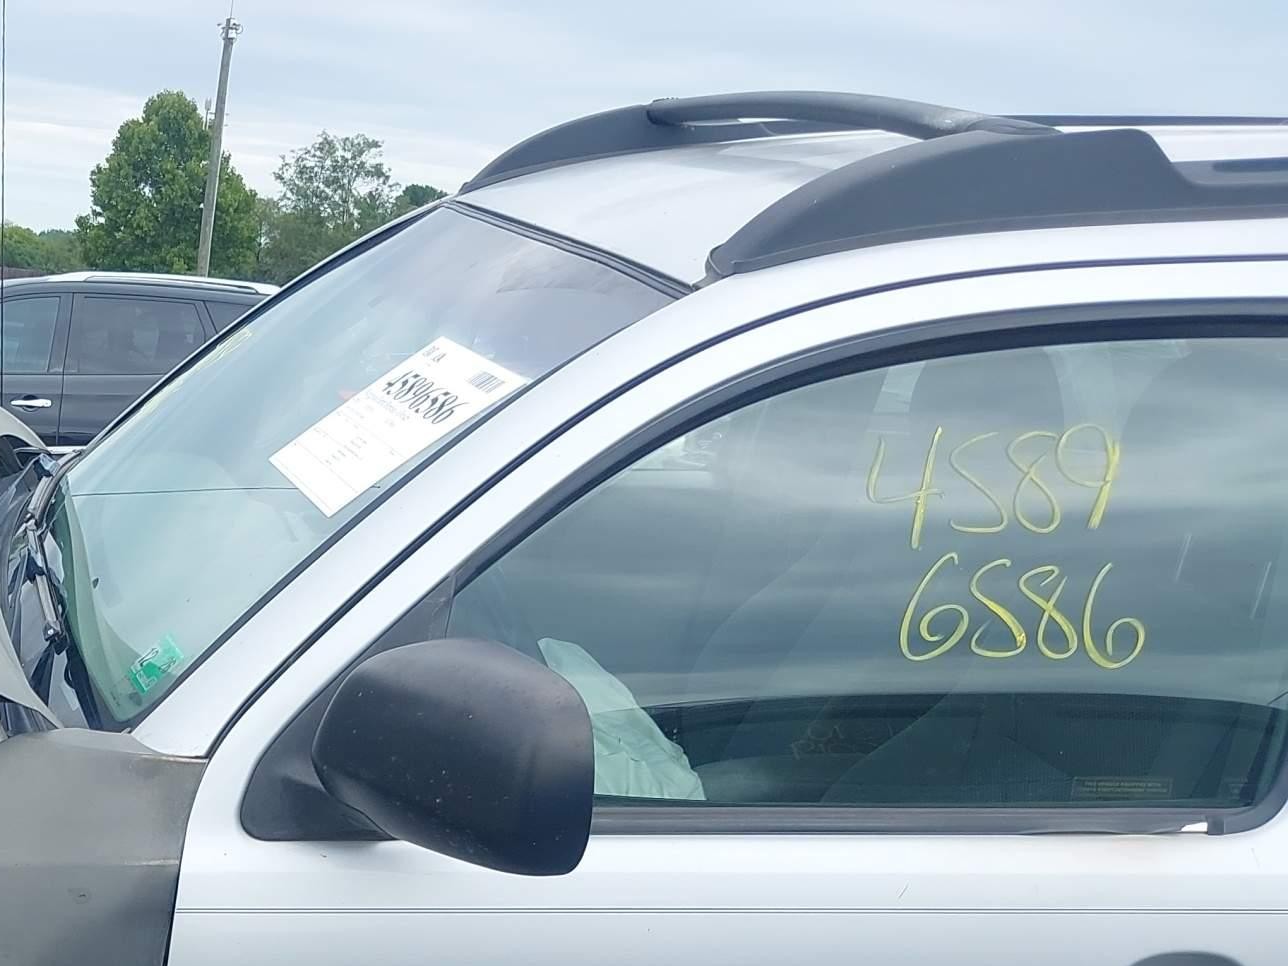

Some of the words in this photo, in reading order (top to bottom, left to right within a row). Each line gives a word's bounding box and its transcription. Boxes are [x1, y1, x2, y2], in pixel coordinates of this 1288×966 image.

[382, 370, 470, 425] 45896586
[865, 423, 1120, 550] 4589
[899, 551, 1146, 669] 6586
